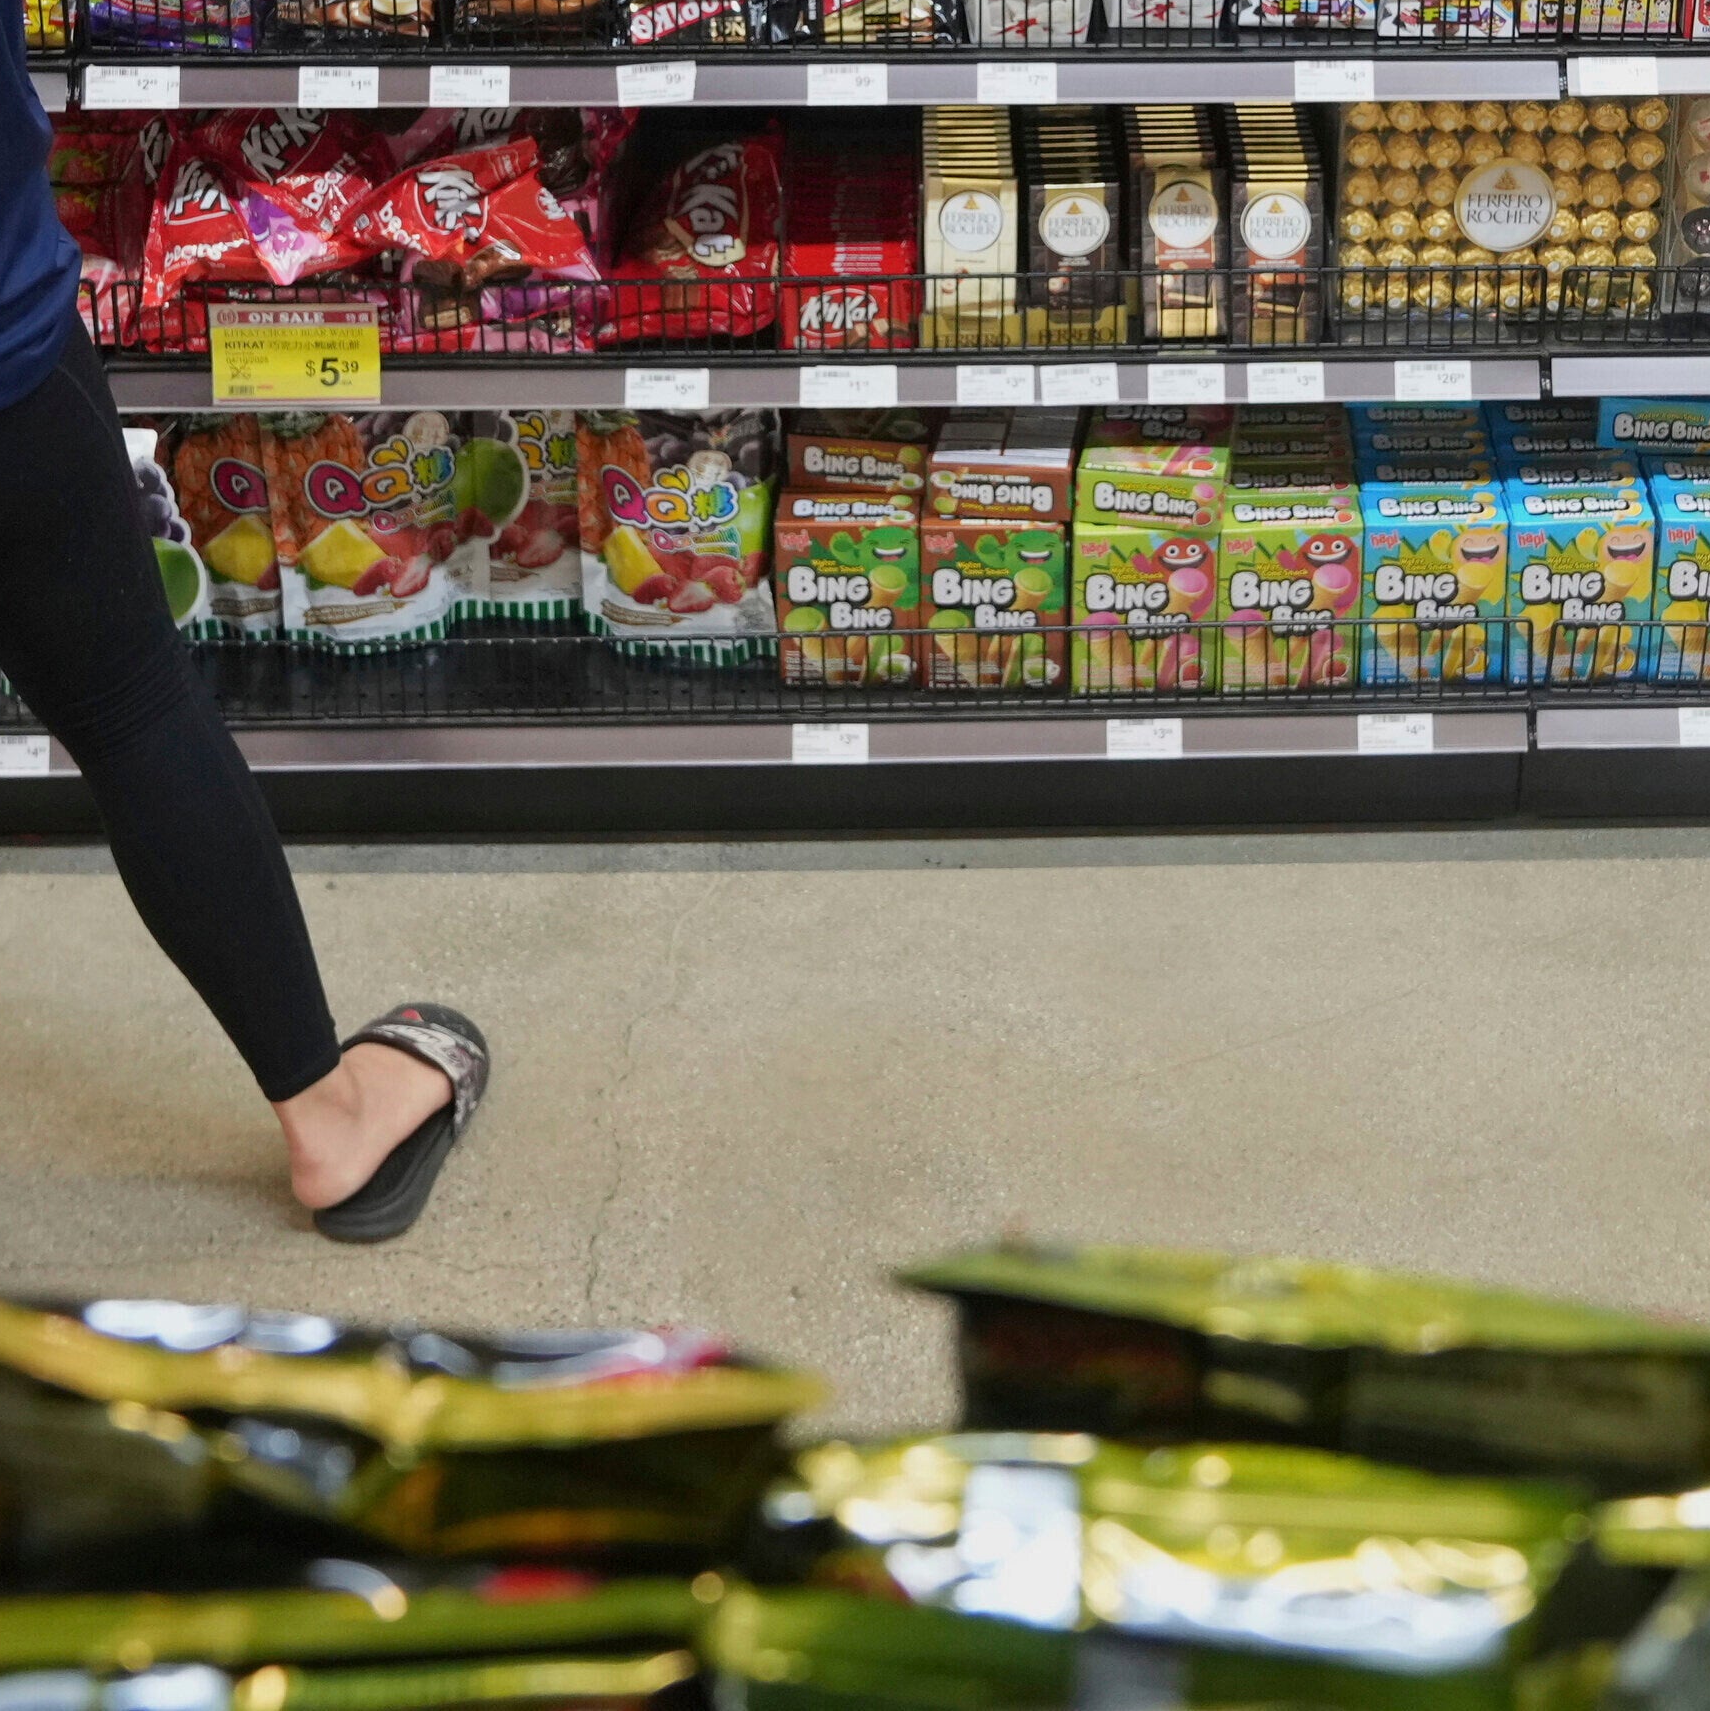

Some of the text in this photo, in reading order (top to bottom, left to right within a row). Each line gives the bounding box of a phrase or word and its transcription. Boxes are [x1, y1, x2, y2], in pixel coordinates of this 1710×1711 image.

[1095, 483, 1198, 516] BING BING
[932, 569, 1012, 605] BING
[1522, 563, 1604, 600] BING
[975, 603, 1037, 629] BING
[1563, 600, 1623, 623] BING
